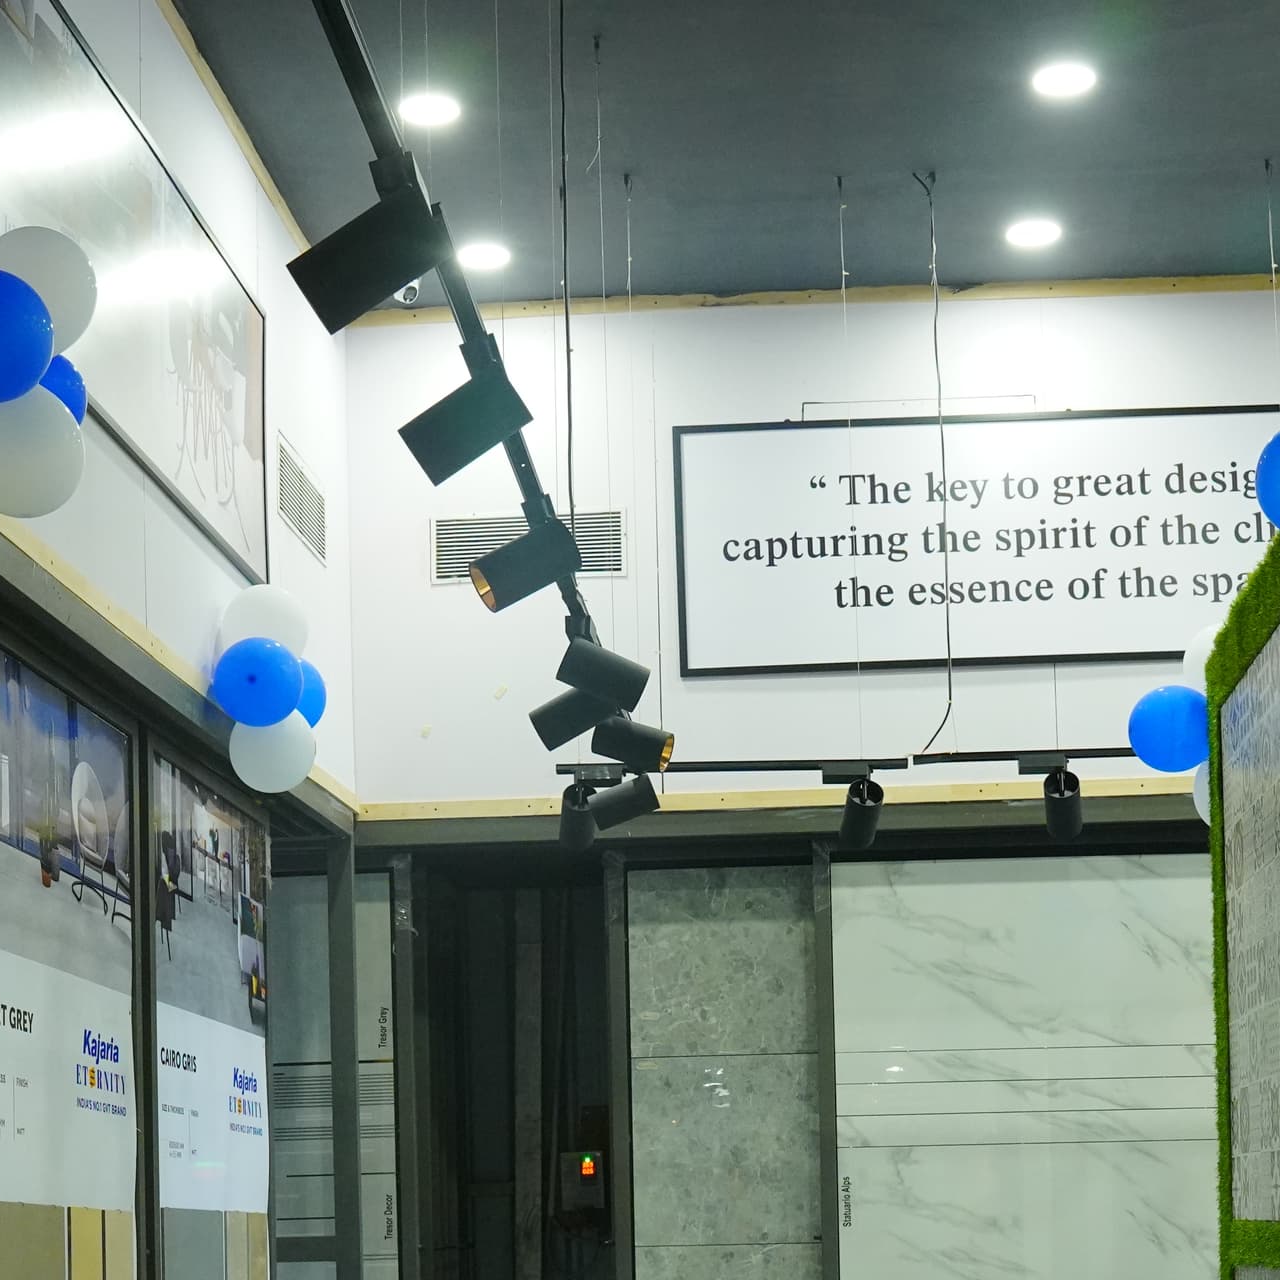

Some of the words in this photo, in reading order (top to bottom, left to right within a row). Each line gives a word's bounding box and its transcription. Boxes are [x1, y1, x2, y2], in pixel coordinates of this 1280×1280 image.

[838, 473, 912, 505] The
[925, 471, 988, 509] key
[1002, 472, 1040, 500] to
[1053, 466, 1152, 505] great
[722, 525, 909, 568] capturing
[922, 521, 981, 554] the
[995, 517, 1097, 558] spirit
[1109, 515, 1150, 547] of
[1160, 513, 1220, 546] the
[834, 576, 894, 609] the
[908, 578, 1054, 606] essence
[1068, 567, 1108, 600] of
[1118, 566, 1178, 598] the
[9, 1007, 34, 1034] GREY
[83, 1028, 120, 1065] Kajaria
[160, 1046, 181, 1070] CAIRO
[182, 1052, 197, 1073] GRIS
[233, 1066, 258, 1095] Kajaria
[841, 1176, 852, 1193] Alps
[384, 1194, 393, 1216] Decor
[842, 1194, 852, 1228] Statuario
[384, 1217, 393, 1241] Tresor
